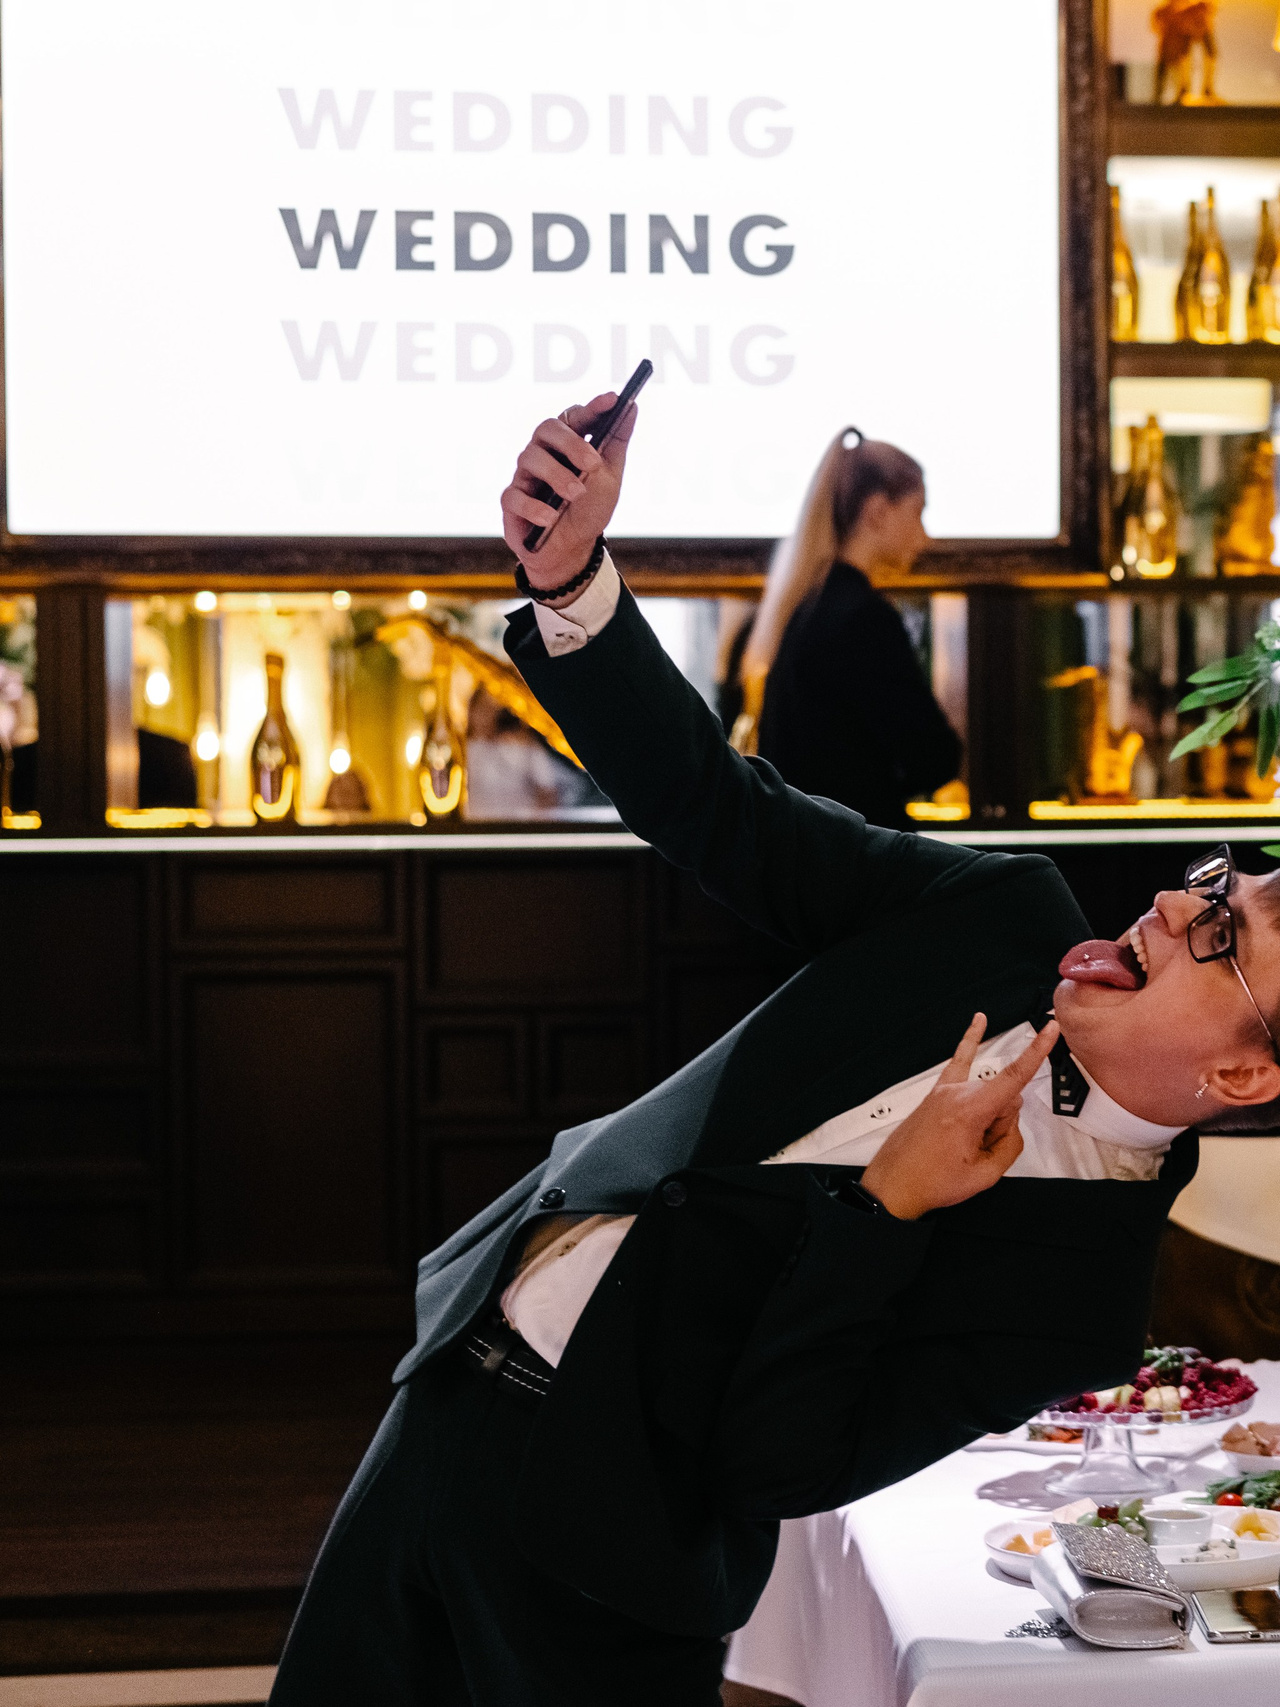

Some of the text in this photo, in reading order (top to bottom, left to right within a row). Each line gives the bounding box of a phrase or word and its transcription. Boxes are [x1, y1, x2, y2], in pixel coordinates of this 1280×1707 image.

[278, 87, 795, 159] WEDDING
[278, 207, 796, 277] WEDDING
[280, 319, 797, 387] WEDDING
